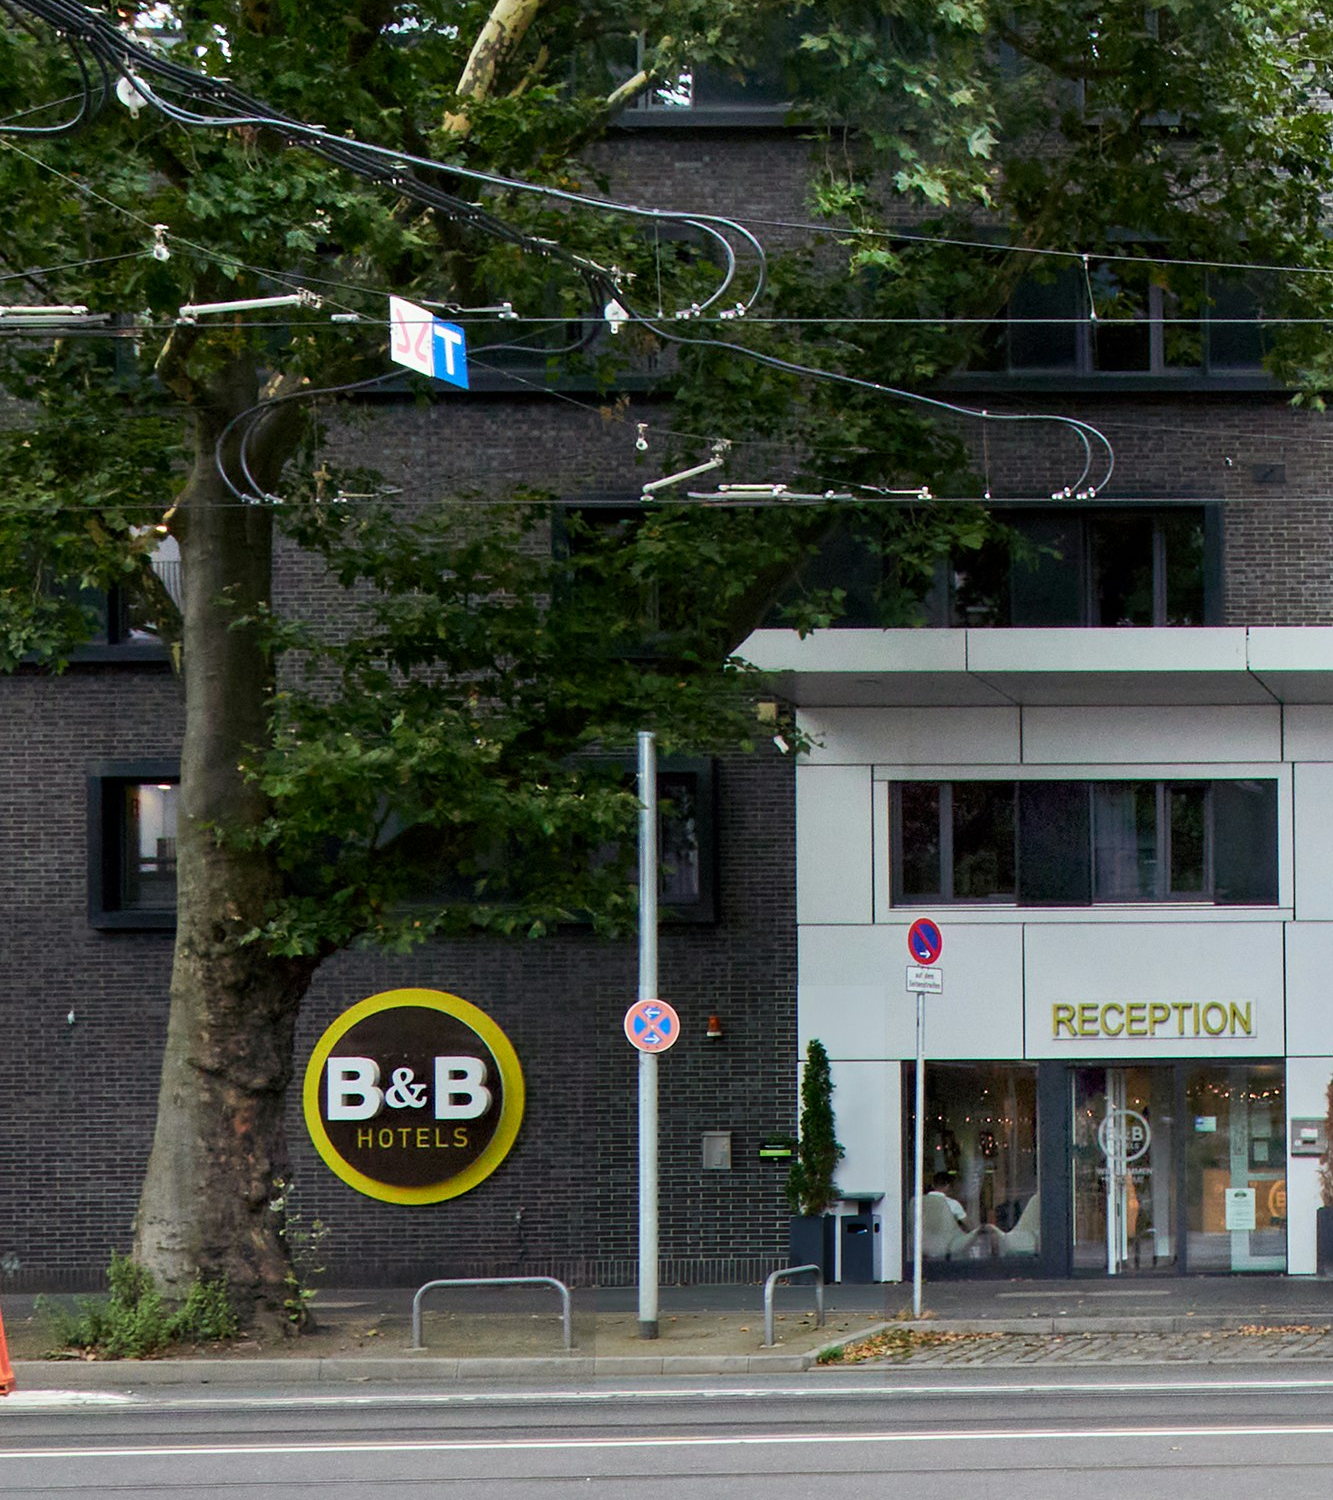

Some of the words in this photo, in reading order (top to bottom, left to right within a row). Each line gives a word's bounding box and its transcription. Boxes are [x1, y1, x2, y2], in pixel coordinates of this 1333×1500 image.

[433, 324, 462, 376] T
[1052, 1001, 1252, 1036] RECEPTION
[327, 1056, 492, 1121] B&B
[357, 1127, 469, 1149] HOTELS
